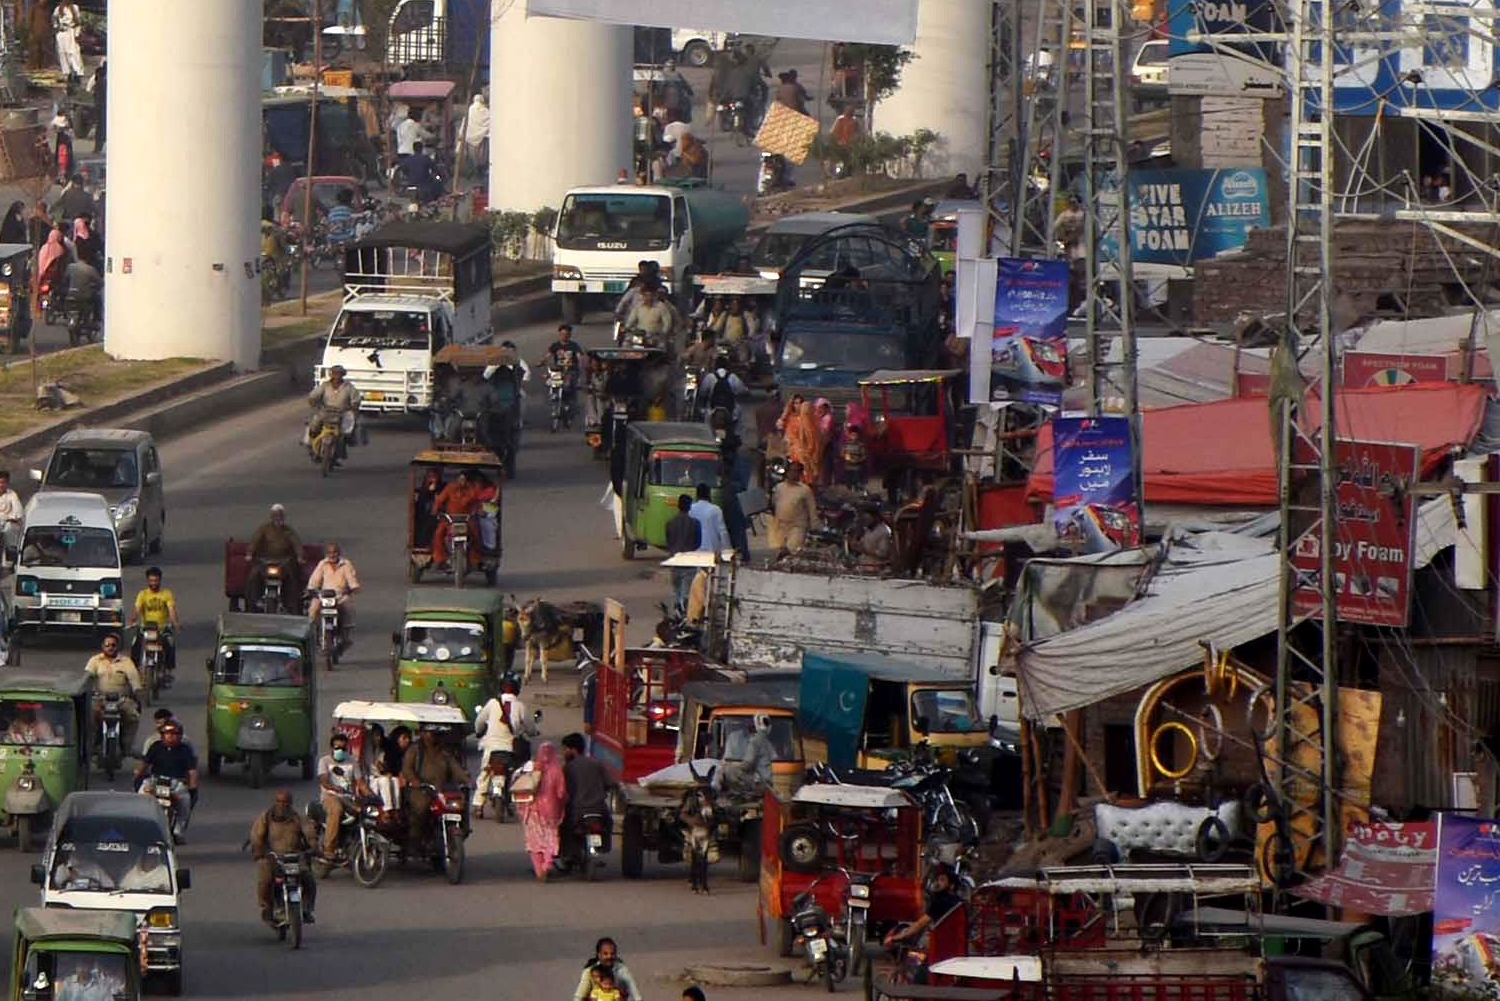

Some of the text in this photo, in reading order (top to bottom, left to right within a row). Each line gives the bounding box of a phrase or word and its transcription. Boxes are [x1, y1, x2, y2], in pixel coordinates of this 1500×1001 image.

[1138, 183, 1181, 205] FIVE
[1138, 205, 1187, 227] STAR
[1206, 202, 1261, 216] ALIZEH
[1136, 229, 1190, 250] FOAM
[1078, 449, 1109, 465] سفر
[1079, 480, 1111, 492] میں
[1358, 541, 1404, 563] Foam
